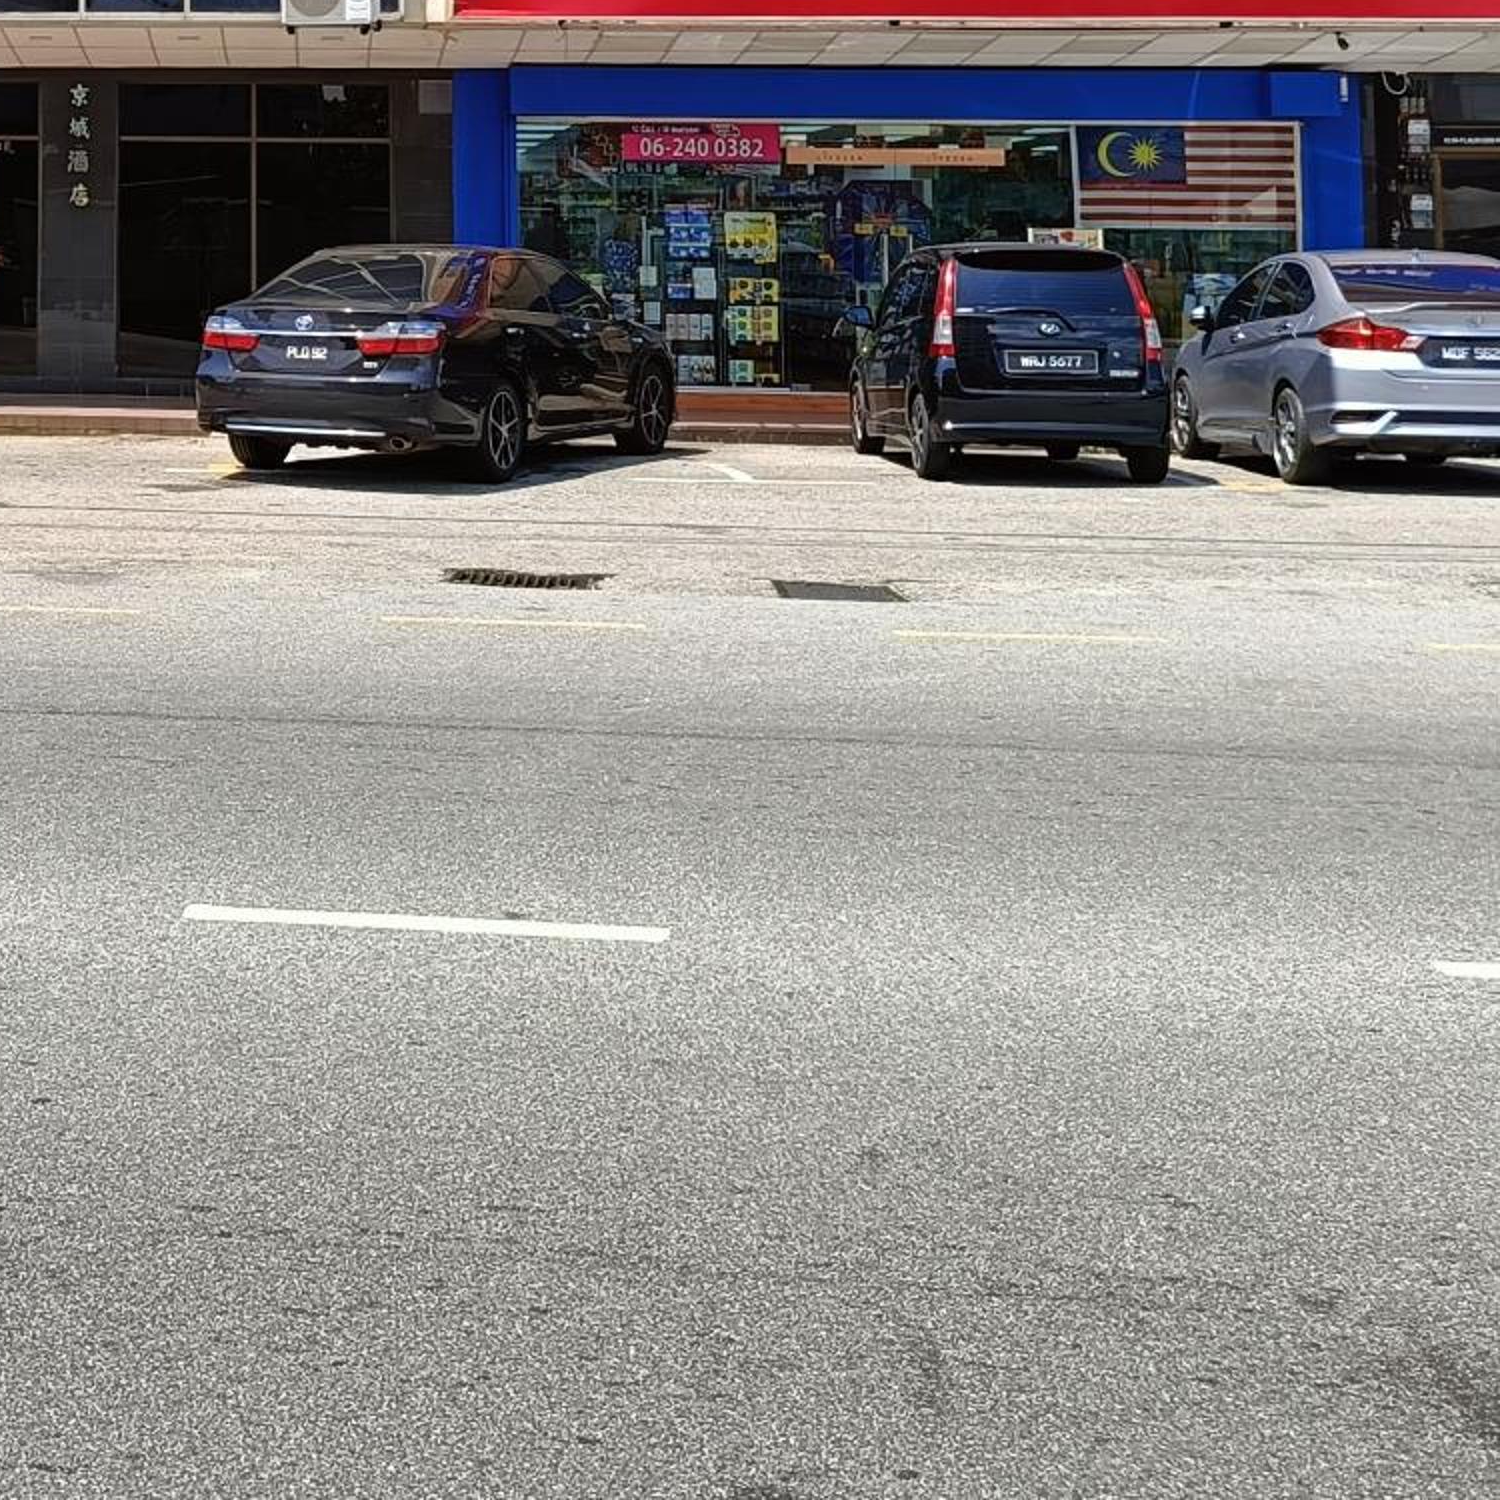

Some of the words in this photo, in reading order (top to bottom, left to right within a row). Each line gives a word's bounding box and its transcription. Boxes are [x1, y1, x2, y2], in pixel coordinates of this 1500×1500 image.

[67, 84, 91, 207] 京城酒店
[639, 137, 709, 157] 06-240
[713, 138, 764, 158] 0382
